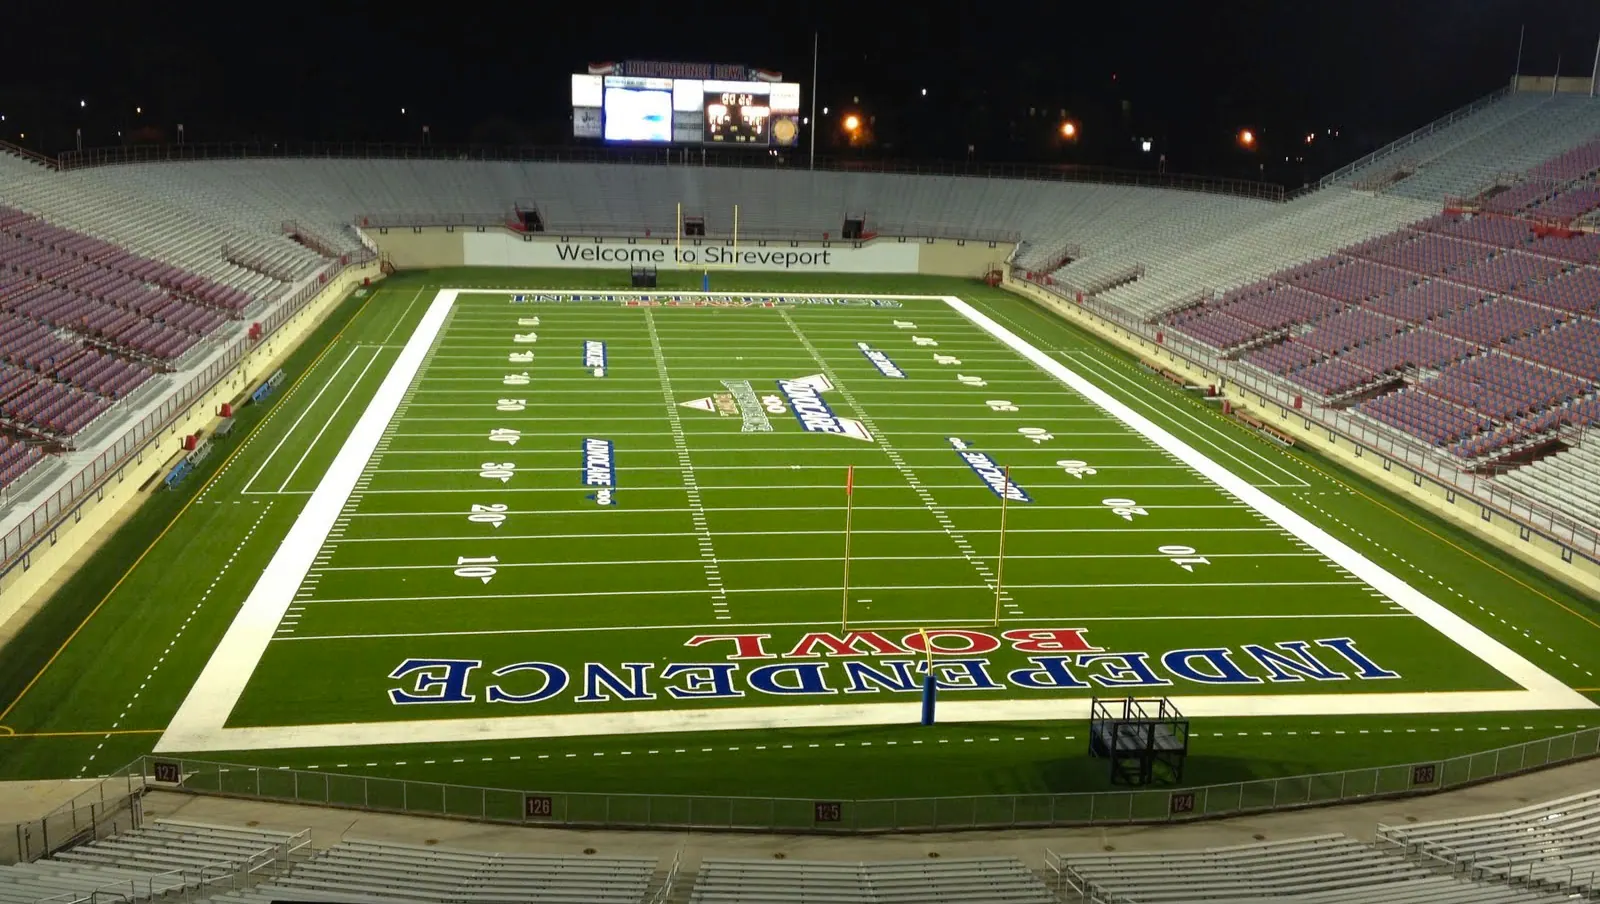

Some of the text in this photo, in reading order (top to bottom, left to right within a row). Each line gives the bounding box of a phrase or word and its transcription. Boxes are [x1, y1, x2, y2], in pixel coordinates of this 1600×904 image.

[555, 244, 831, 268] Welcome to Shreveport
[496, 399, 526, 411] 50
[780, 380, 842, 433] ADVOCARE
[479, 462, 515, 478] 30
[586, 438, 611, 486] ADVOCARE
[1056, 460, 1097, 476] 30
[467, 504, 508, 522] 20
[1102, 498, 1149, 516] 20
[1158, 545, 1211, 566] 10
[453, 556, 499, 577] 10
[684, 627, 1105, 660] BOWL
[388, 637, 1402, 705] INDEPENDENCE
[156, 765, 176, 780] 127
[1415, 767, 1433, 782] 123
[528, 799, 550, 814] 126
[817, 805, 839, 820] 125
[1174, 796, 1193, 812] 124
